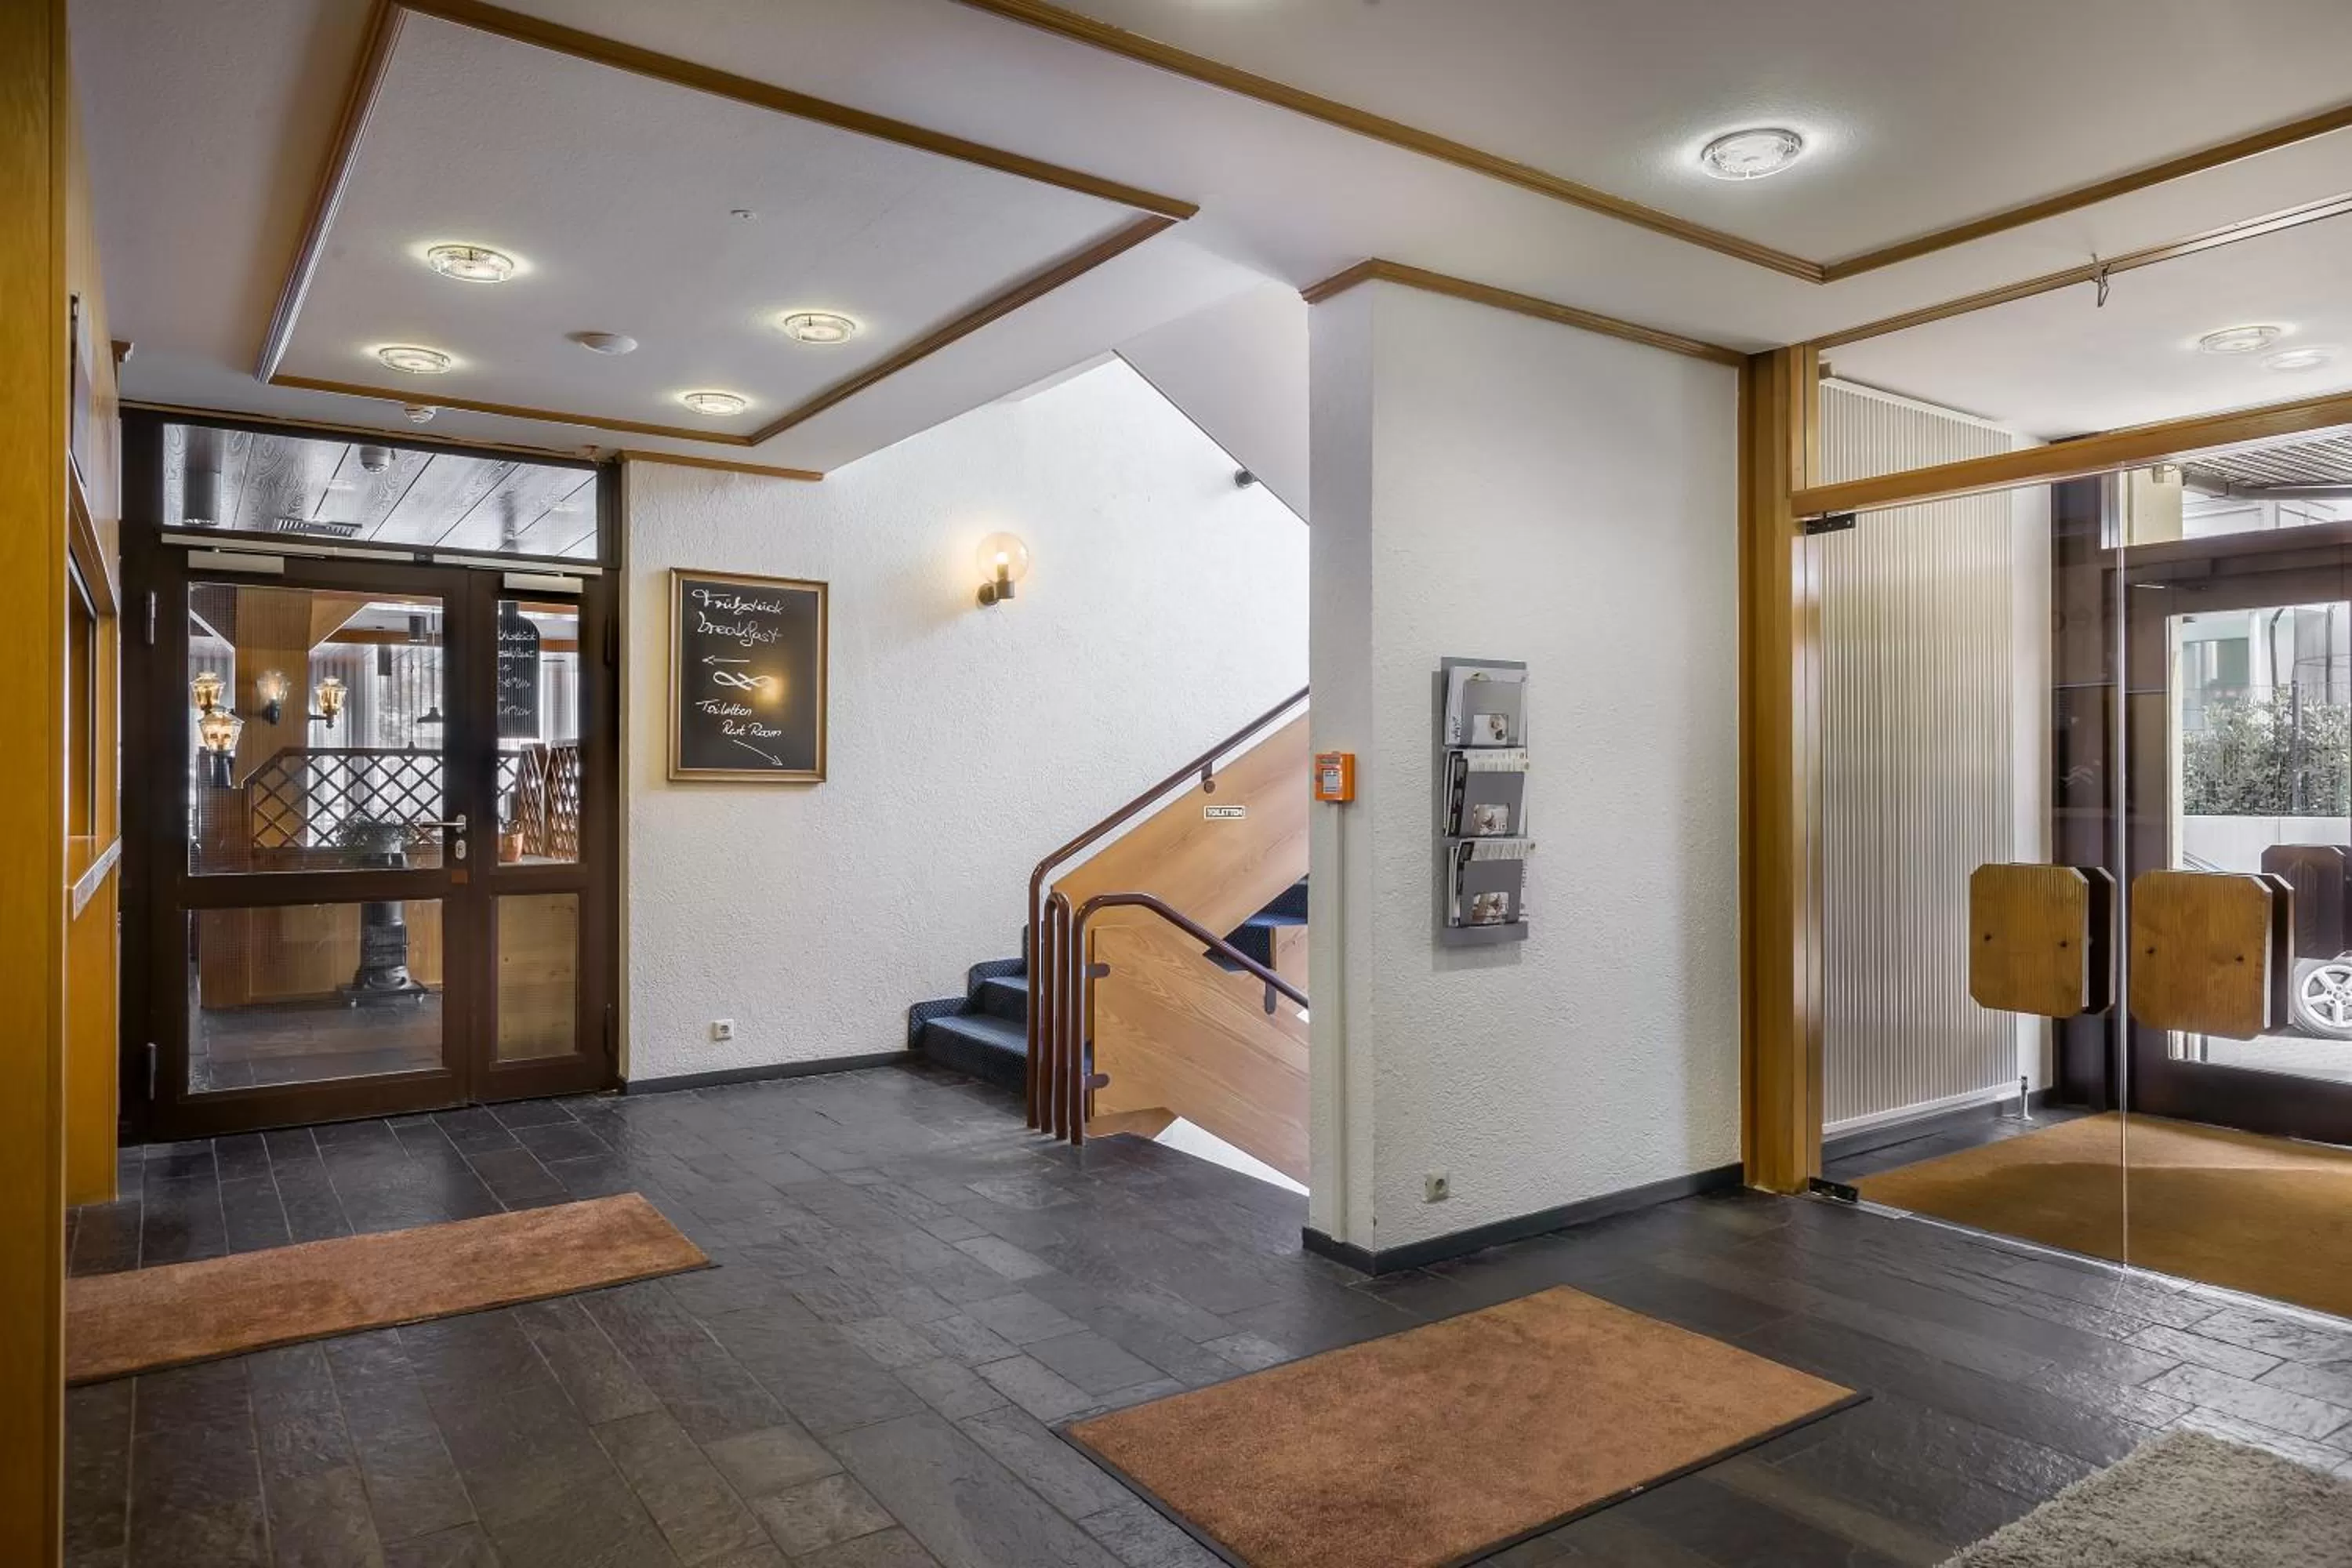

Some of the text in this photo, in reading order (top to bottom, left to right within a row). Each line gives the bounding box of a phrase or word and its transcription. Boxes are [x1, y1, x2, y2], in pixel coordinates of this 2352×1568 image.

[695, 699, 753, 717] Toiletten
[722, 719, 782, 737] Rest Room
